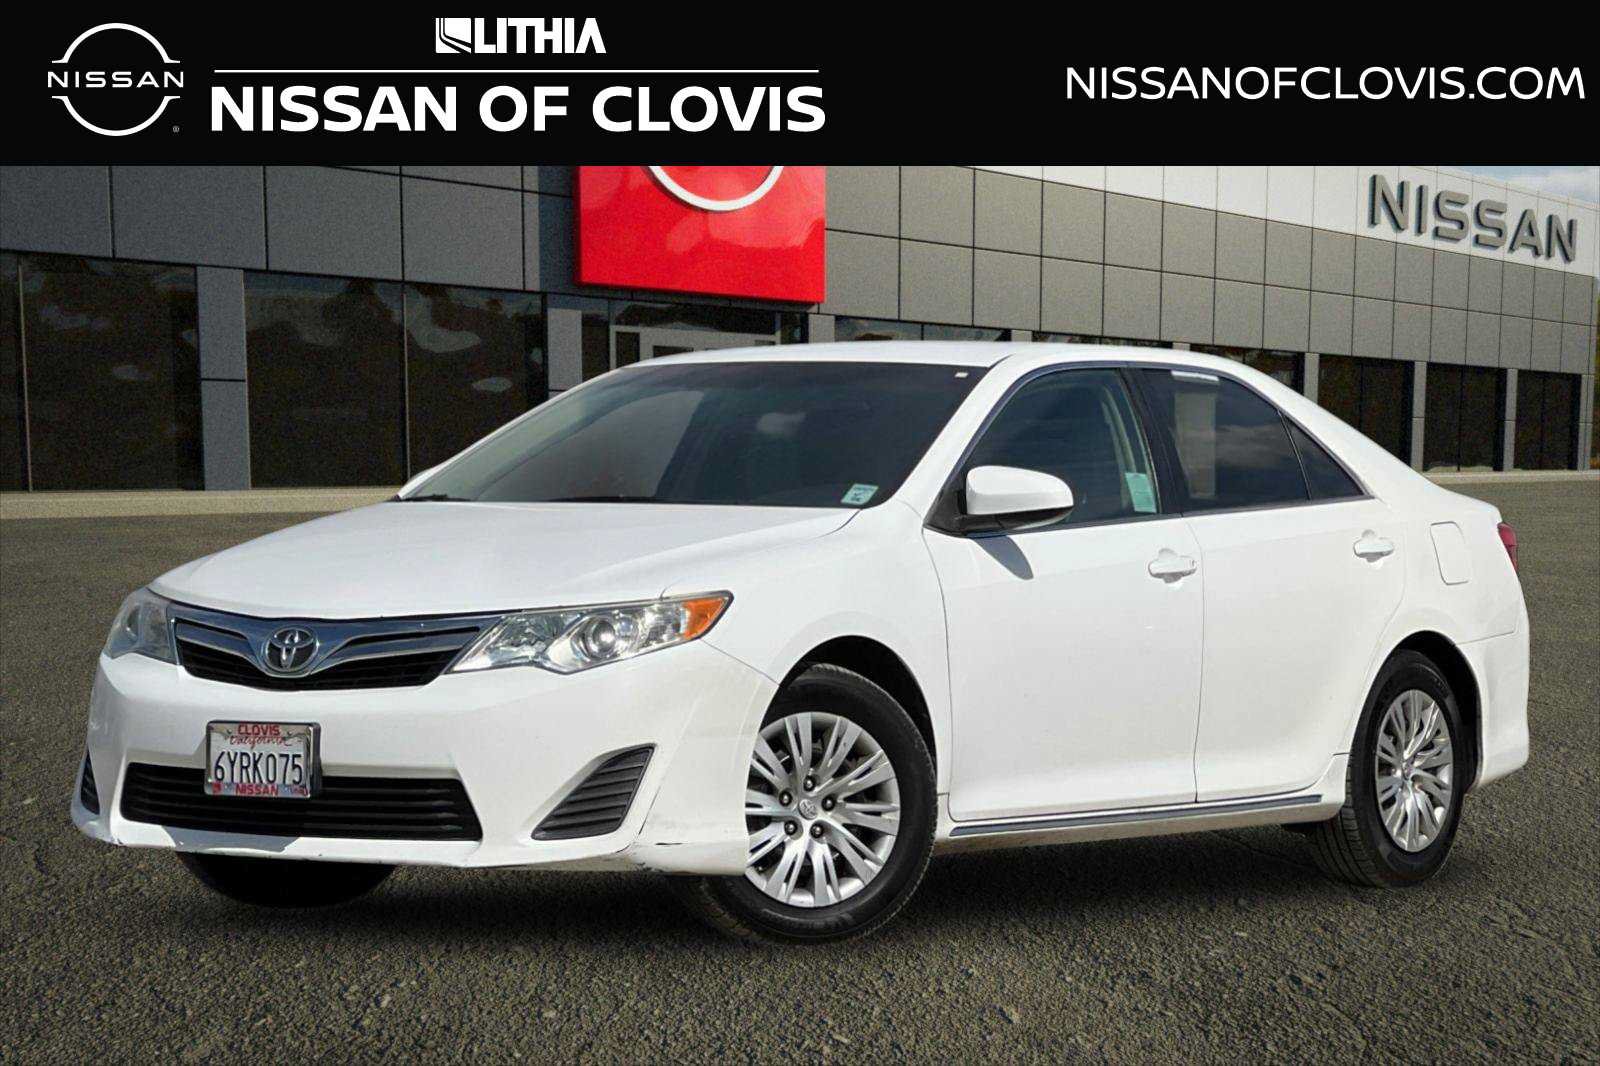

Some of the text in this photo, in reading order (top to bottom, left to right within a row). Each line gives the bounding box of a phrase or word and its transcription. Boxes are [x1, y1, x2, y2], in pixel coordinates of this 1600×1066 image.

[1368, 174, 1577, 262] NISSAN
[238, 724, 281, 736] CLOVIS
[214, 751, 302, 785] 6YRK075
[235, 783, 279, 796] NISSAN
